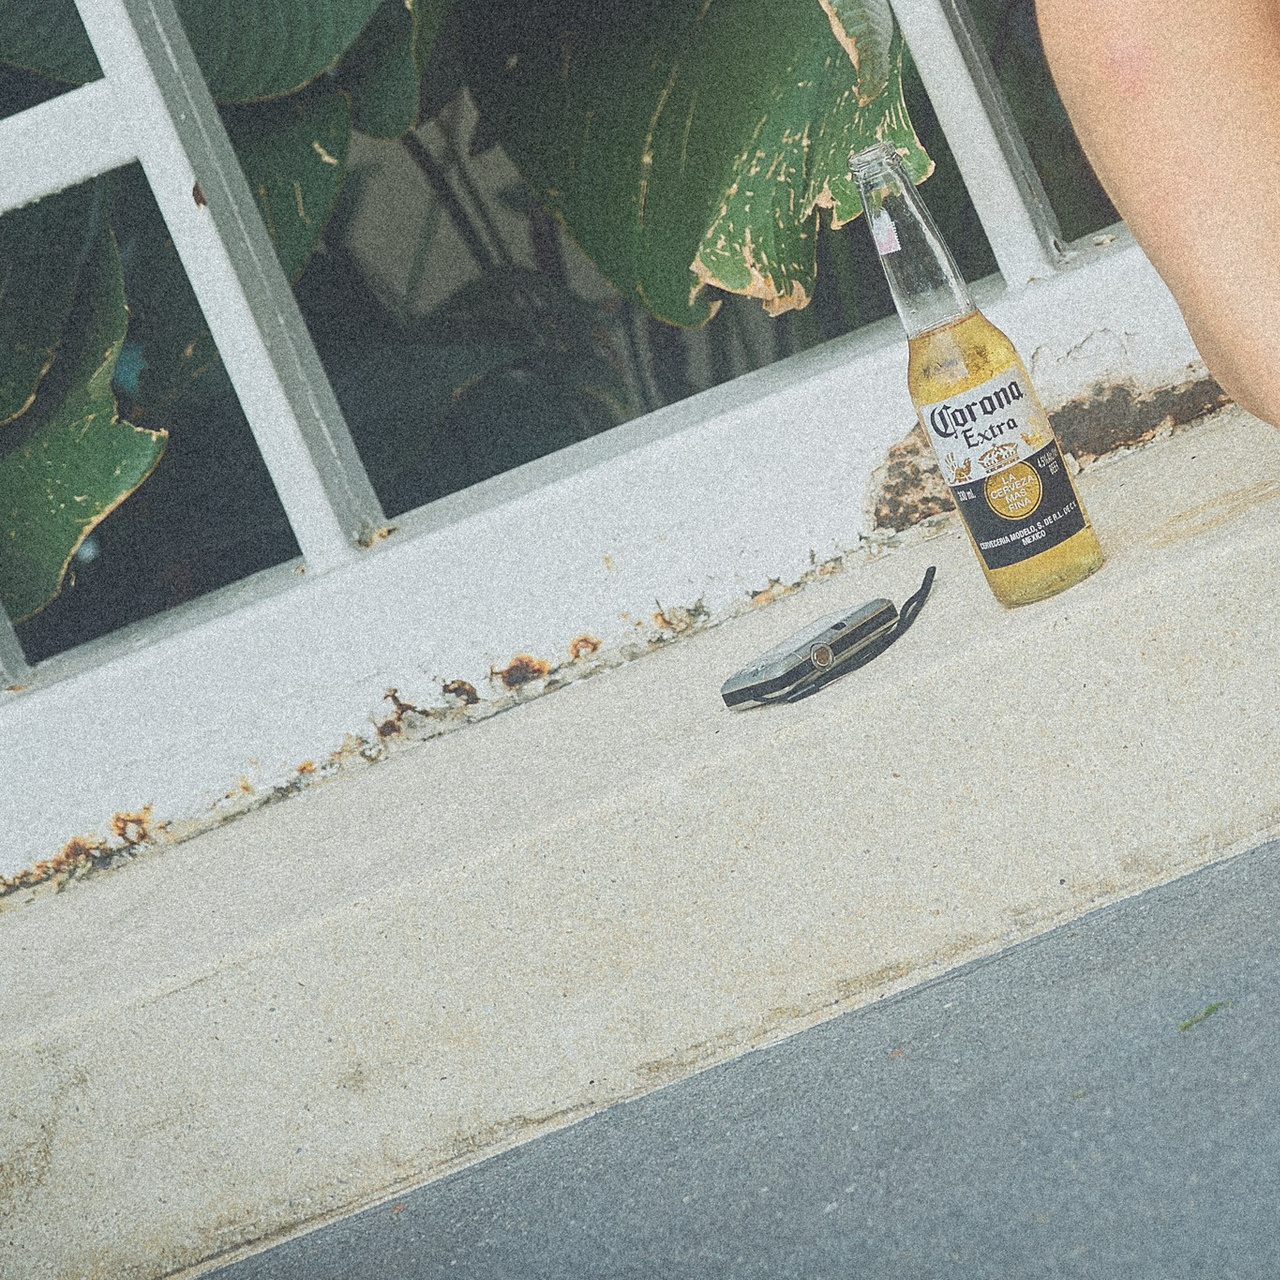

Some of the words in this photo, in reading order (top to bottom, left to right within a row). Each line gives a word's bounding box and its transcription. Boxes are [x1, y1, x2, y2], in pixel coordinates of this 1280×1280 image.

[930, 381, 1024, 439] Corona
[961, 418, 1018, 449] Extra
[990, 475, 1035, 499] CERVEZA
[1001, 473, 1016, 485] LA
[1005, 489, 1027, 504] MAS
[1008, 497, 1032, 512] FINA
[1043, 515, 1054, 526] DE
[1021, 529, 1046, 546] MEXICO
